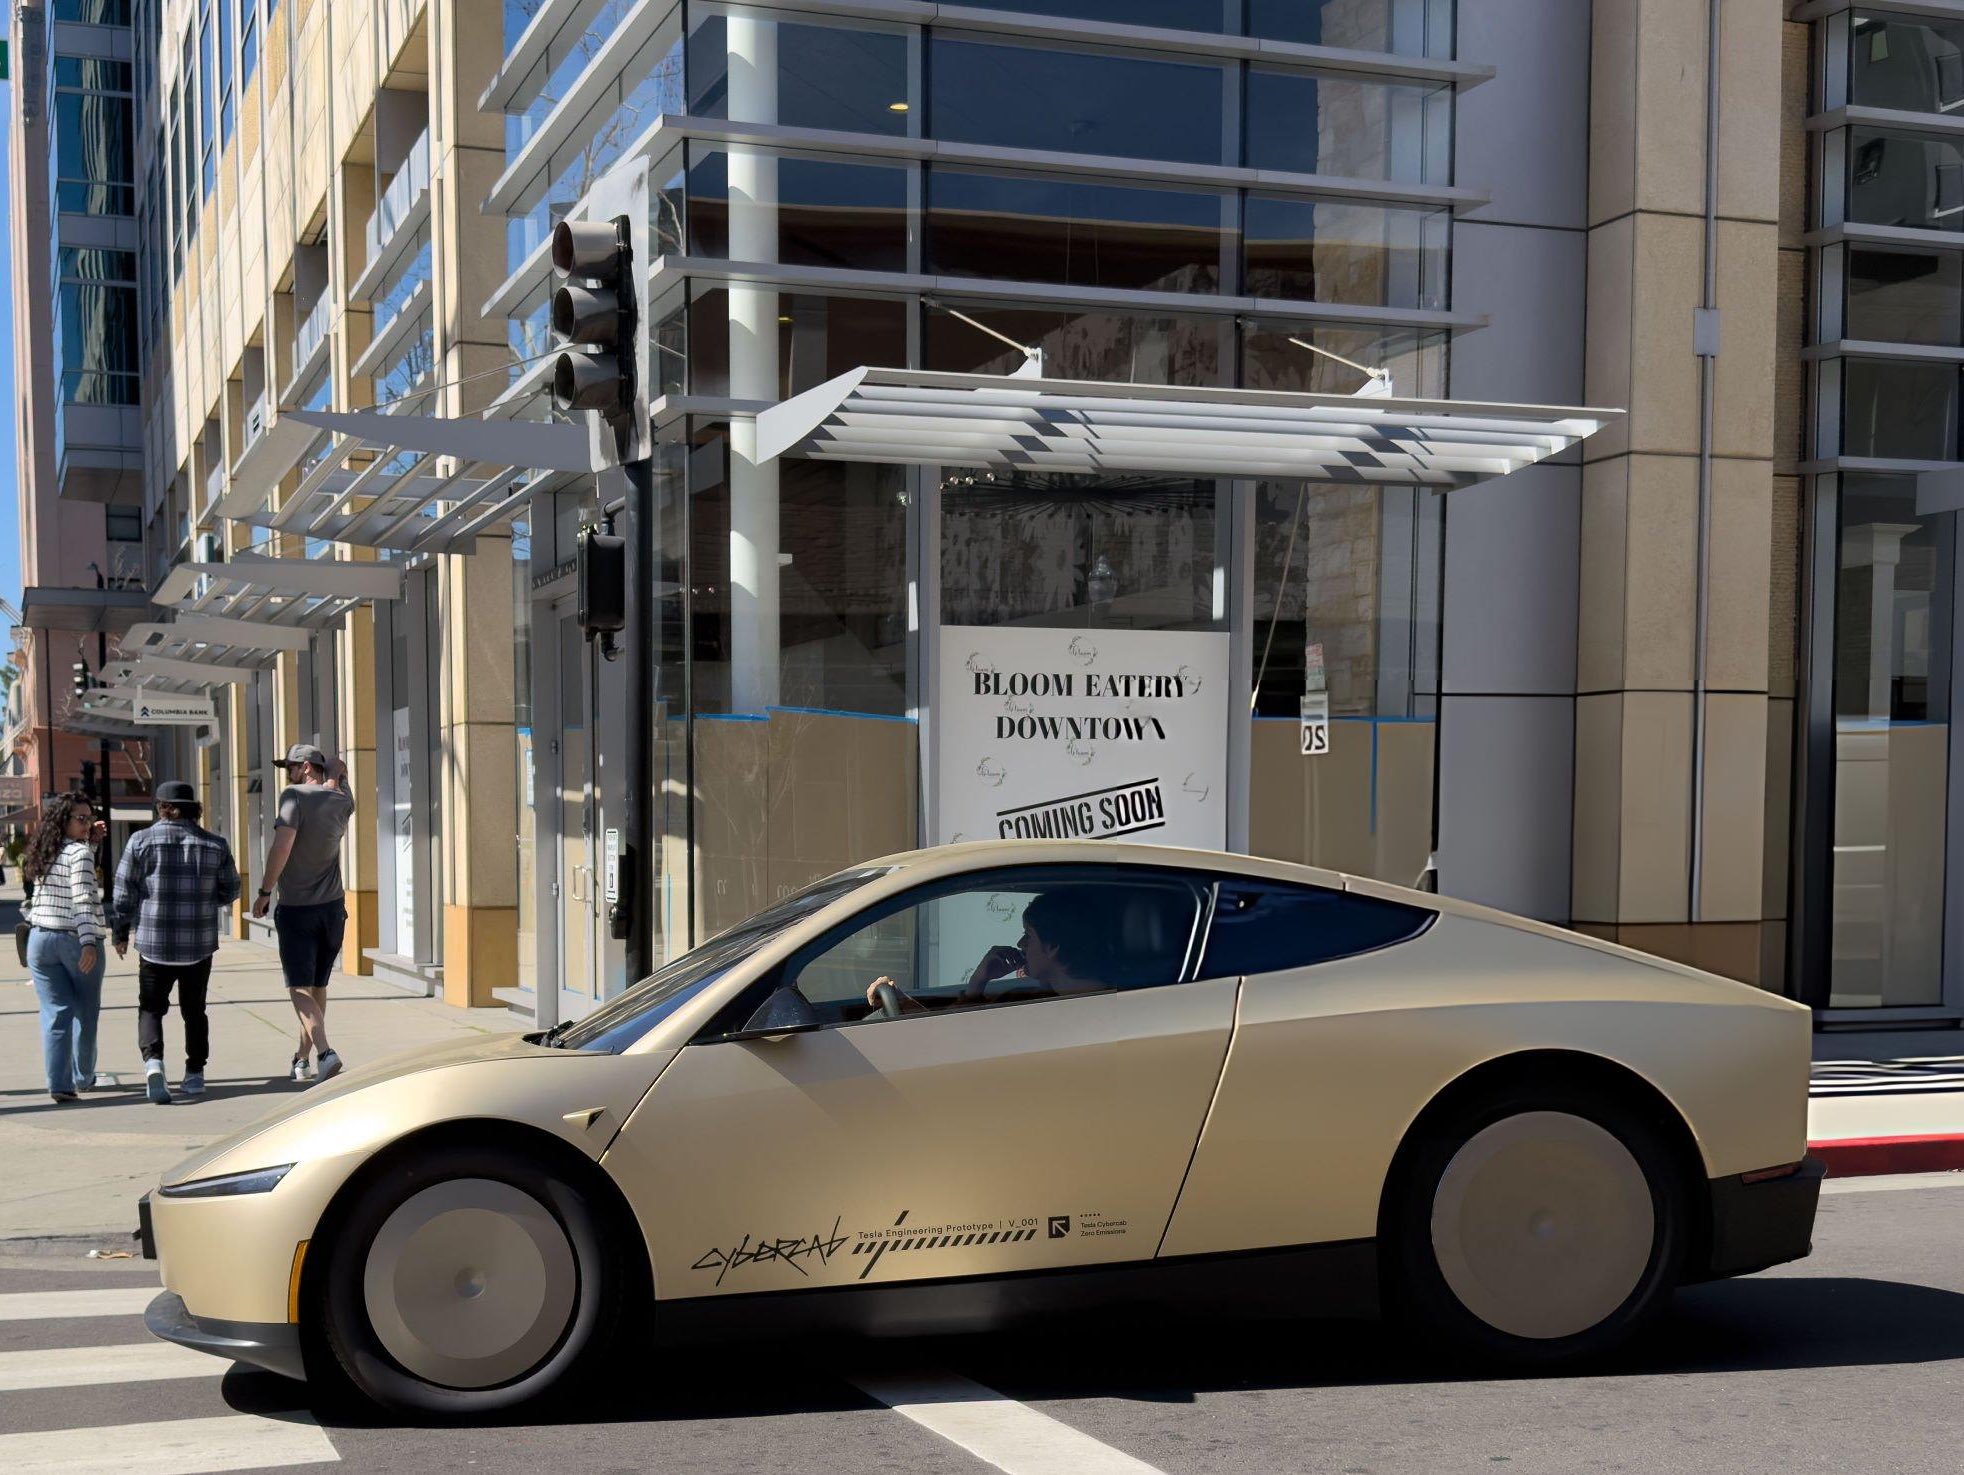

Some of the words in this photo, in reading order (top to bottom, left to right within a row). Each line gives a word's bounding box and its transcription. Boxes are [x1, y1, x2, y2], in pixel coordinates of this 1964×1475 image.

[973, 672, 1073, 697] BLOOM
[1085, 674, 1186, 698] EATERY
[1099, 785, 1165, 830] SOON
[858, 1231, 883, 1240] Tesla
[886, 1226, 943, 1238] Engineering
[946, 1222, 994, 1233] Prototype
[1008, 1218, 1038, 1229] V_001
